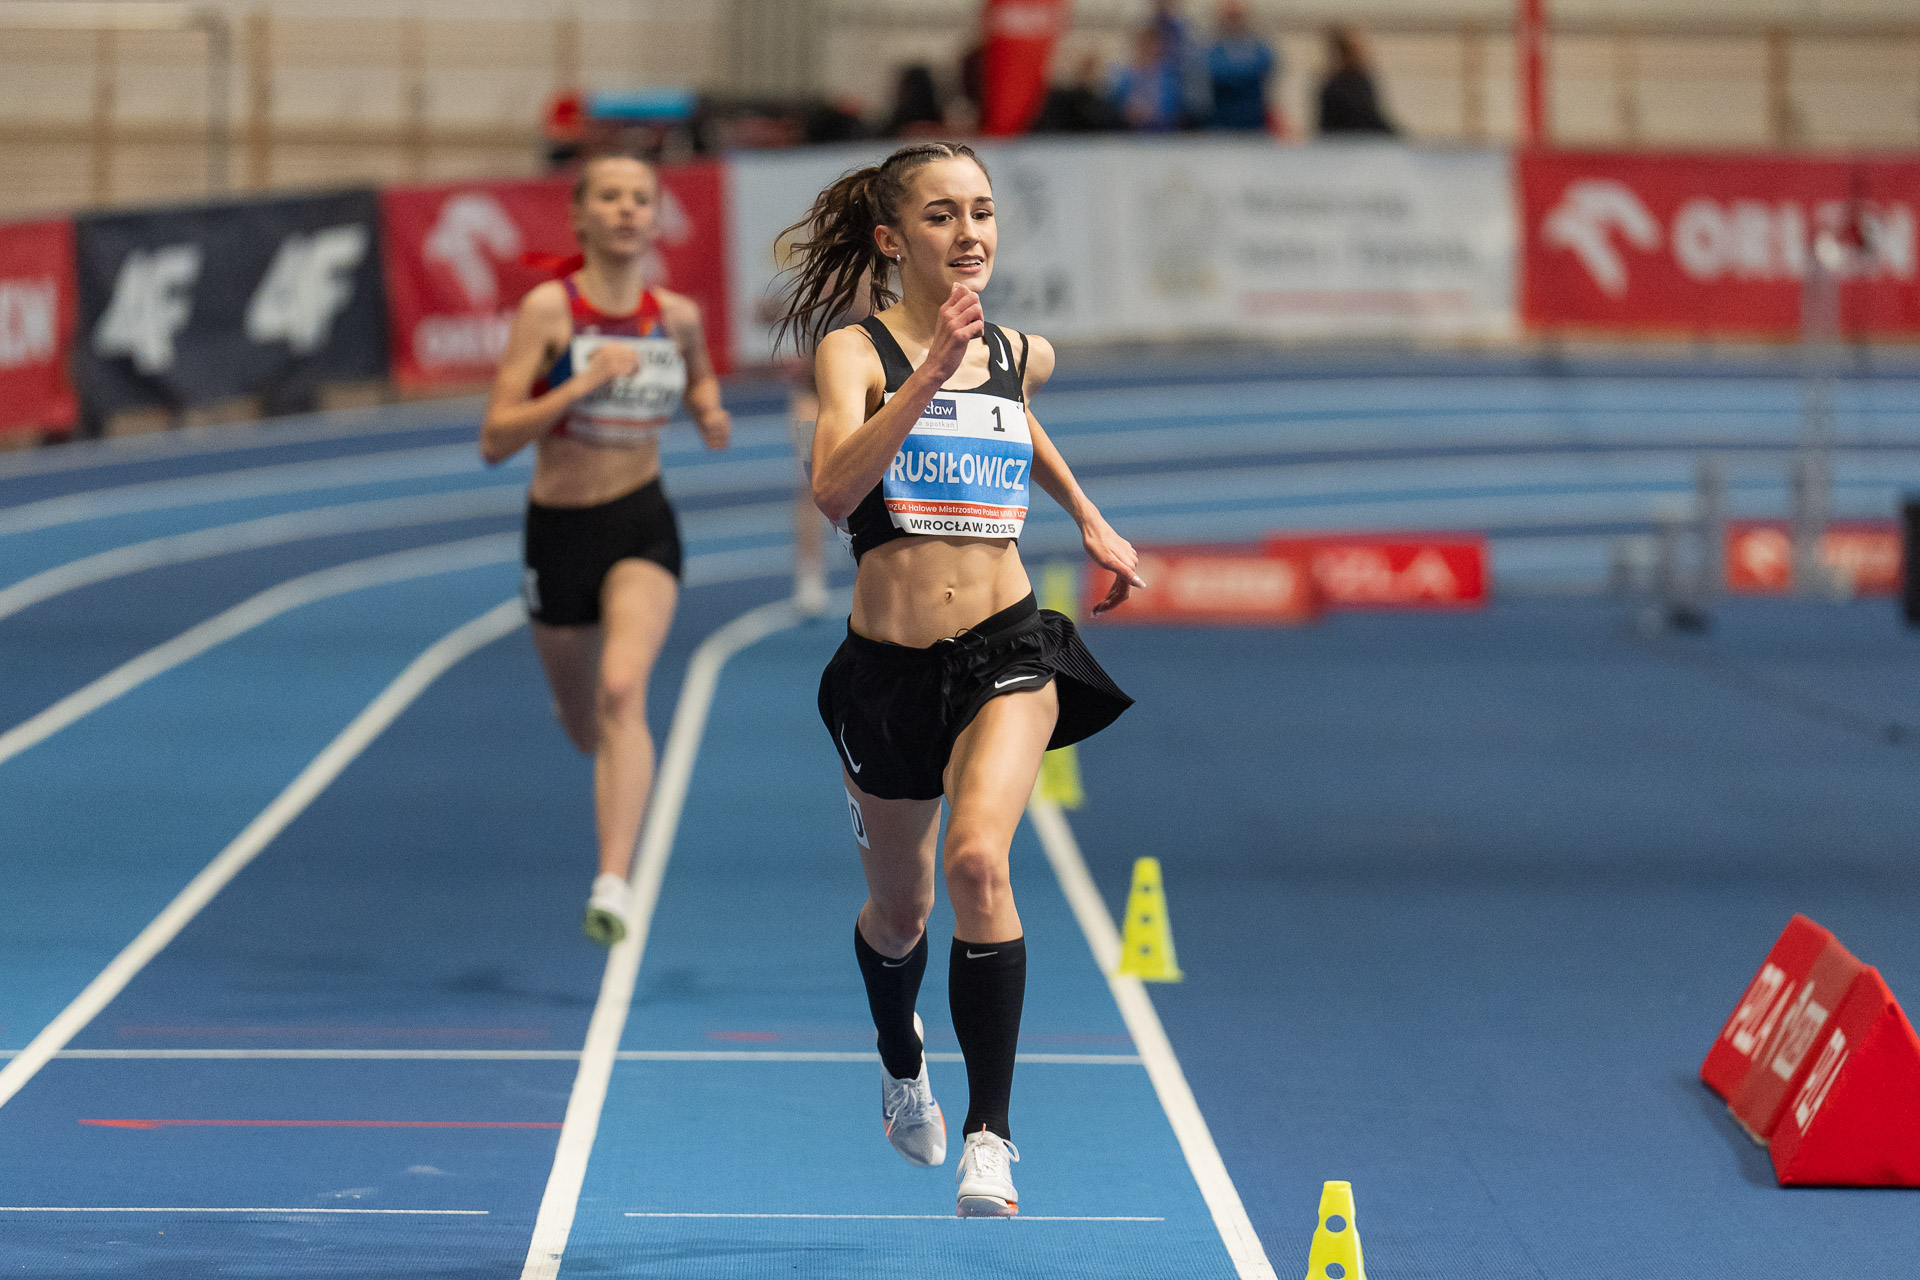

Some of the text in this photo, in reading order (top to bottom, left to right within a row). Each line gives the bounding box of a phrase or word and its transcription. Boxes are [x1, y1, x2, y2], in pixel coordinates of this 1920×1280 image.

[246, 225, 368, 352] 4F
[96, 246, 200, 371] 4F
[924, 401, 953, 415] cław
[991, 406, 1006, 432] 1
[890, 451, 1027, 491] RUSIŁOWICZ
[908, 504, 937, 513] Halowe
[938, 505, 982, 515] Mistrzostwa
[982, 508, 999, 517] Polski
[909, 518, 1016, 534] WROCŁAW 2025
